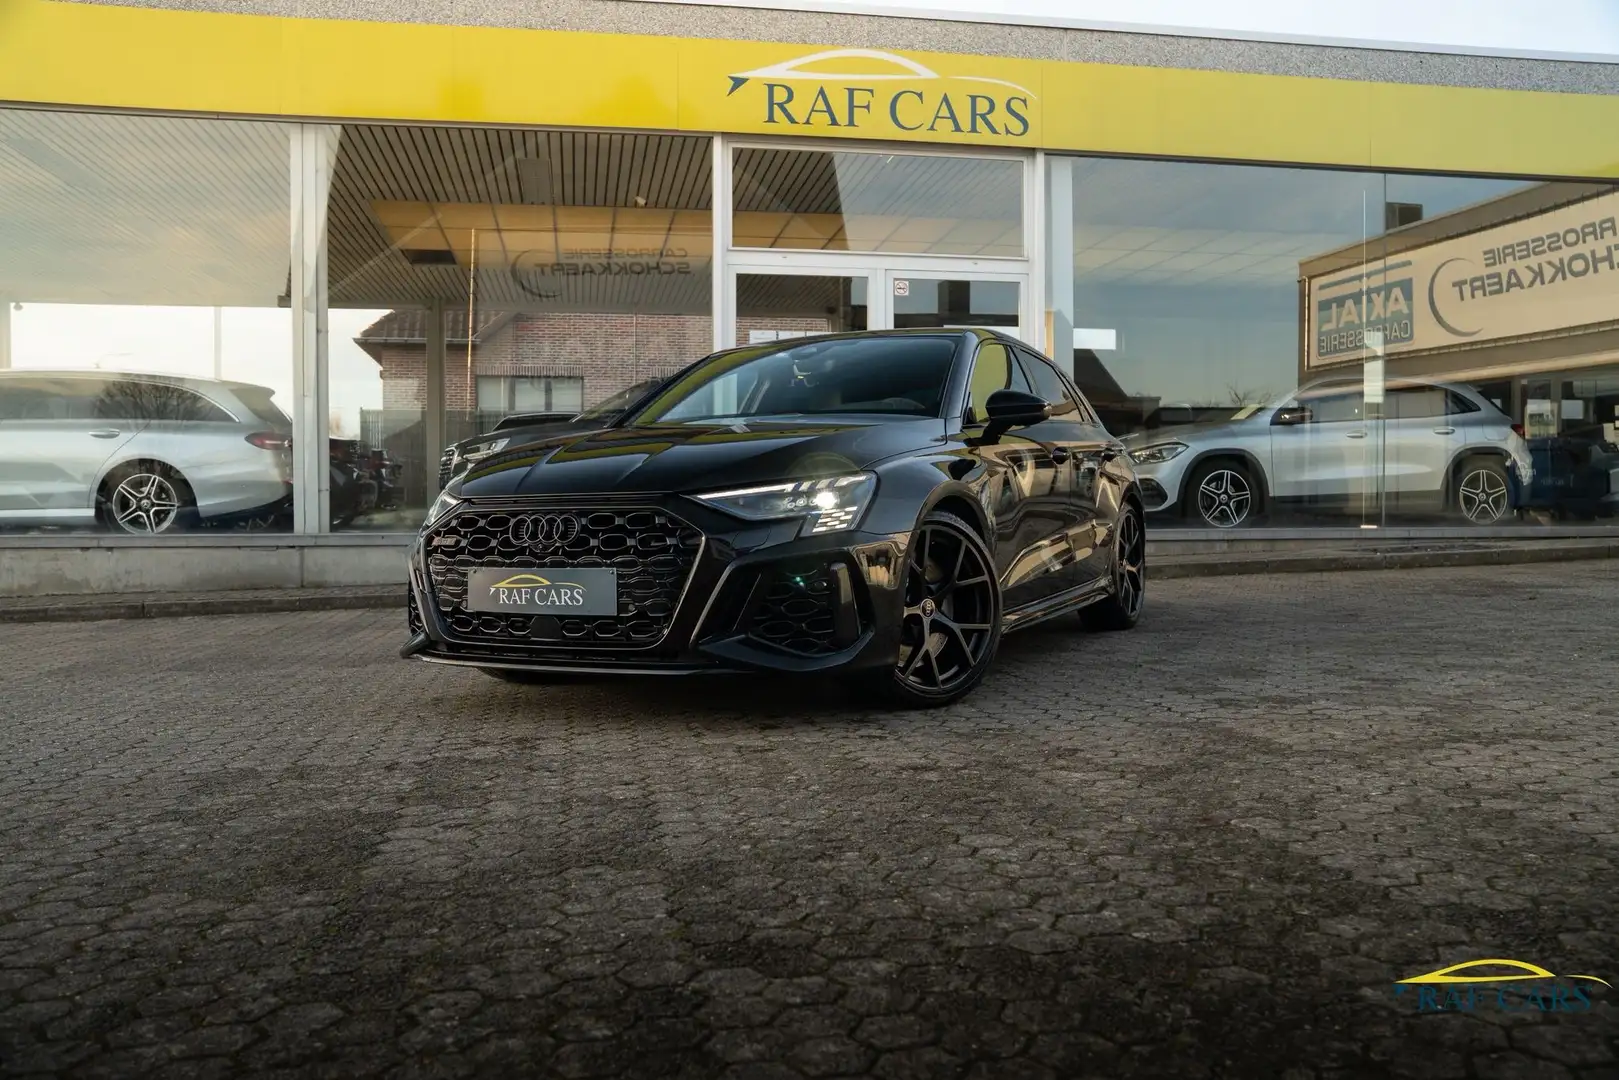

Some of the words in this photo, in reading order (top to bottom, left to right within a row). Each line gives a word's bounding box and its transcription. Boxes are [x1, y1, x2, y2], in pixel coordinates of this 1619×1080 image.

[763, 82, 875, 128] RAF
[889, 89, 1030, 137] CARS
[499, 587, 531, 605] RAF
[534, 587, 584, 606] CARS
